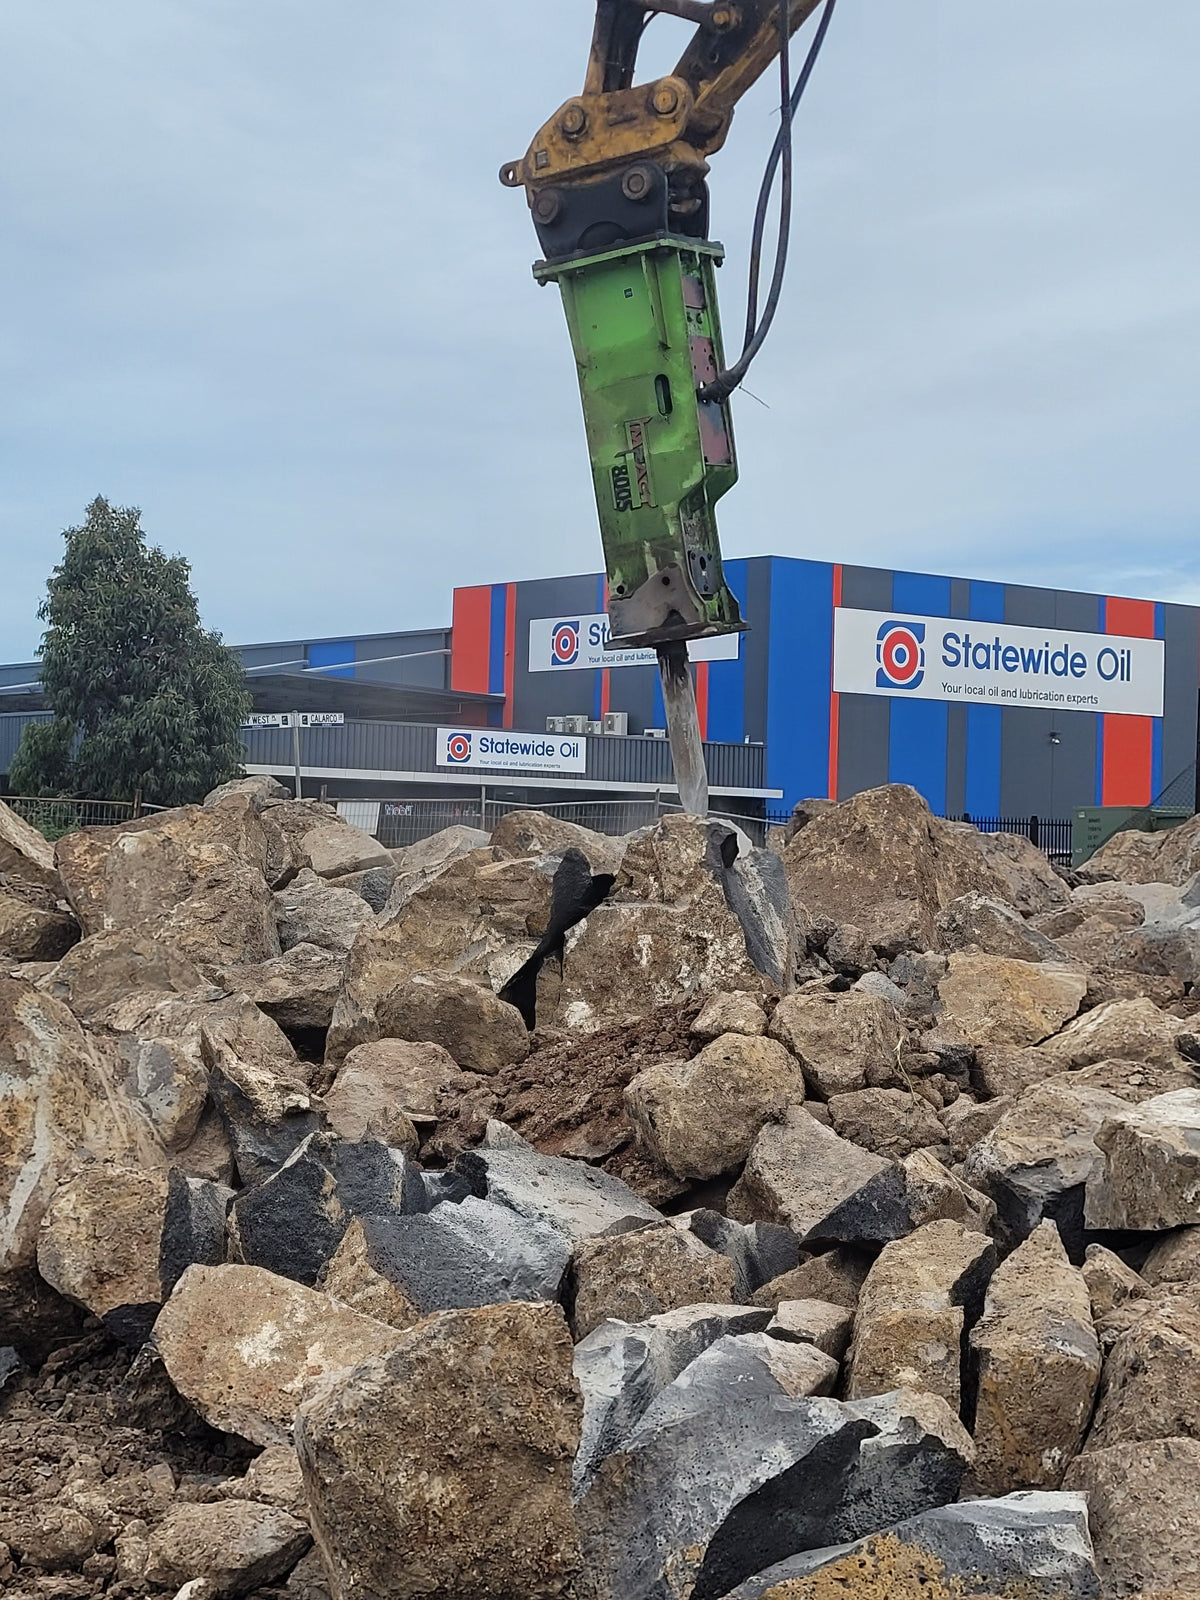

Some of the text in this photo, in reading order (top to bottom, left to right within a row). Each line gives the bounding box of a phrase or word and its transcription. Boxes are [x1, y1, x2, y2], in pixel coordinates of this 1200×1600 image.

[602, 654, 615, 662] local
[625, 653, 635, 661] and
[636, 652, 655, 660] lubrica
[941, 632, 1131, 682] Statewide Oil
[941, 682, 1099, 705] Your local oil and lubrication experts
[252, 715, 269, 724] WEST
[310, 713, 337, 723] CALARCO
[479, 737, 579, 758] Statewide Oil
